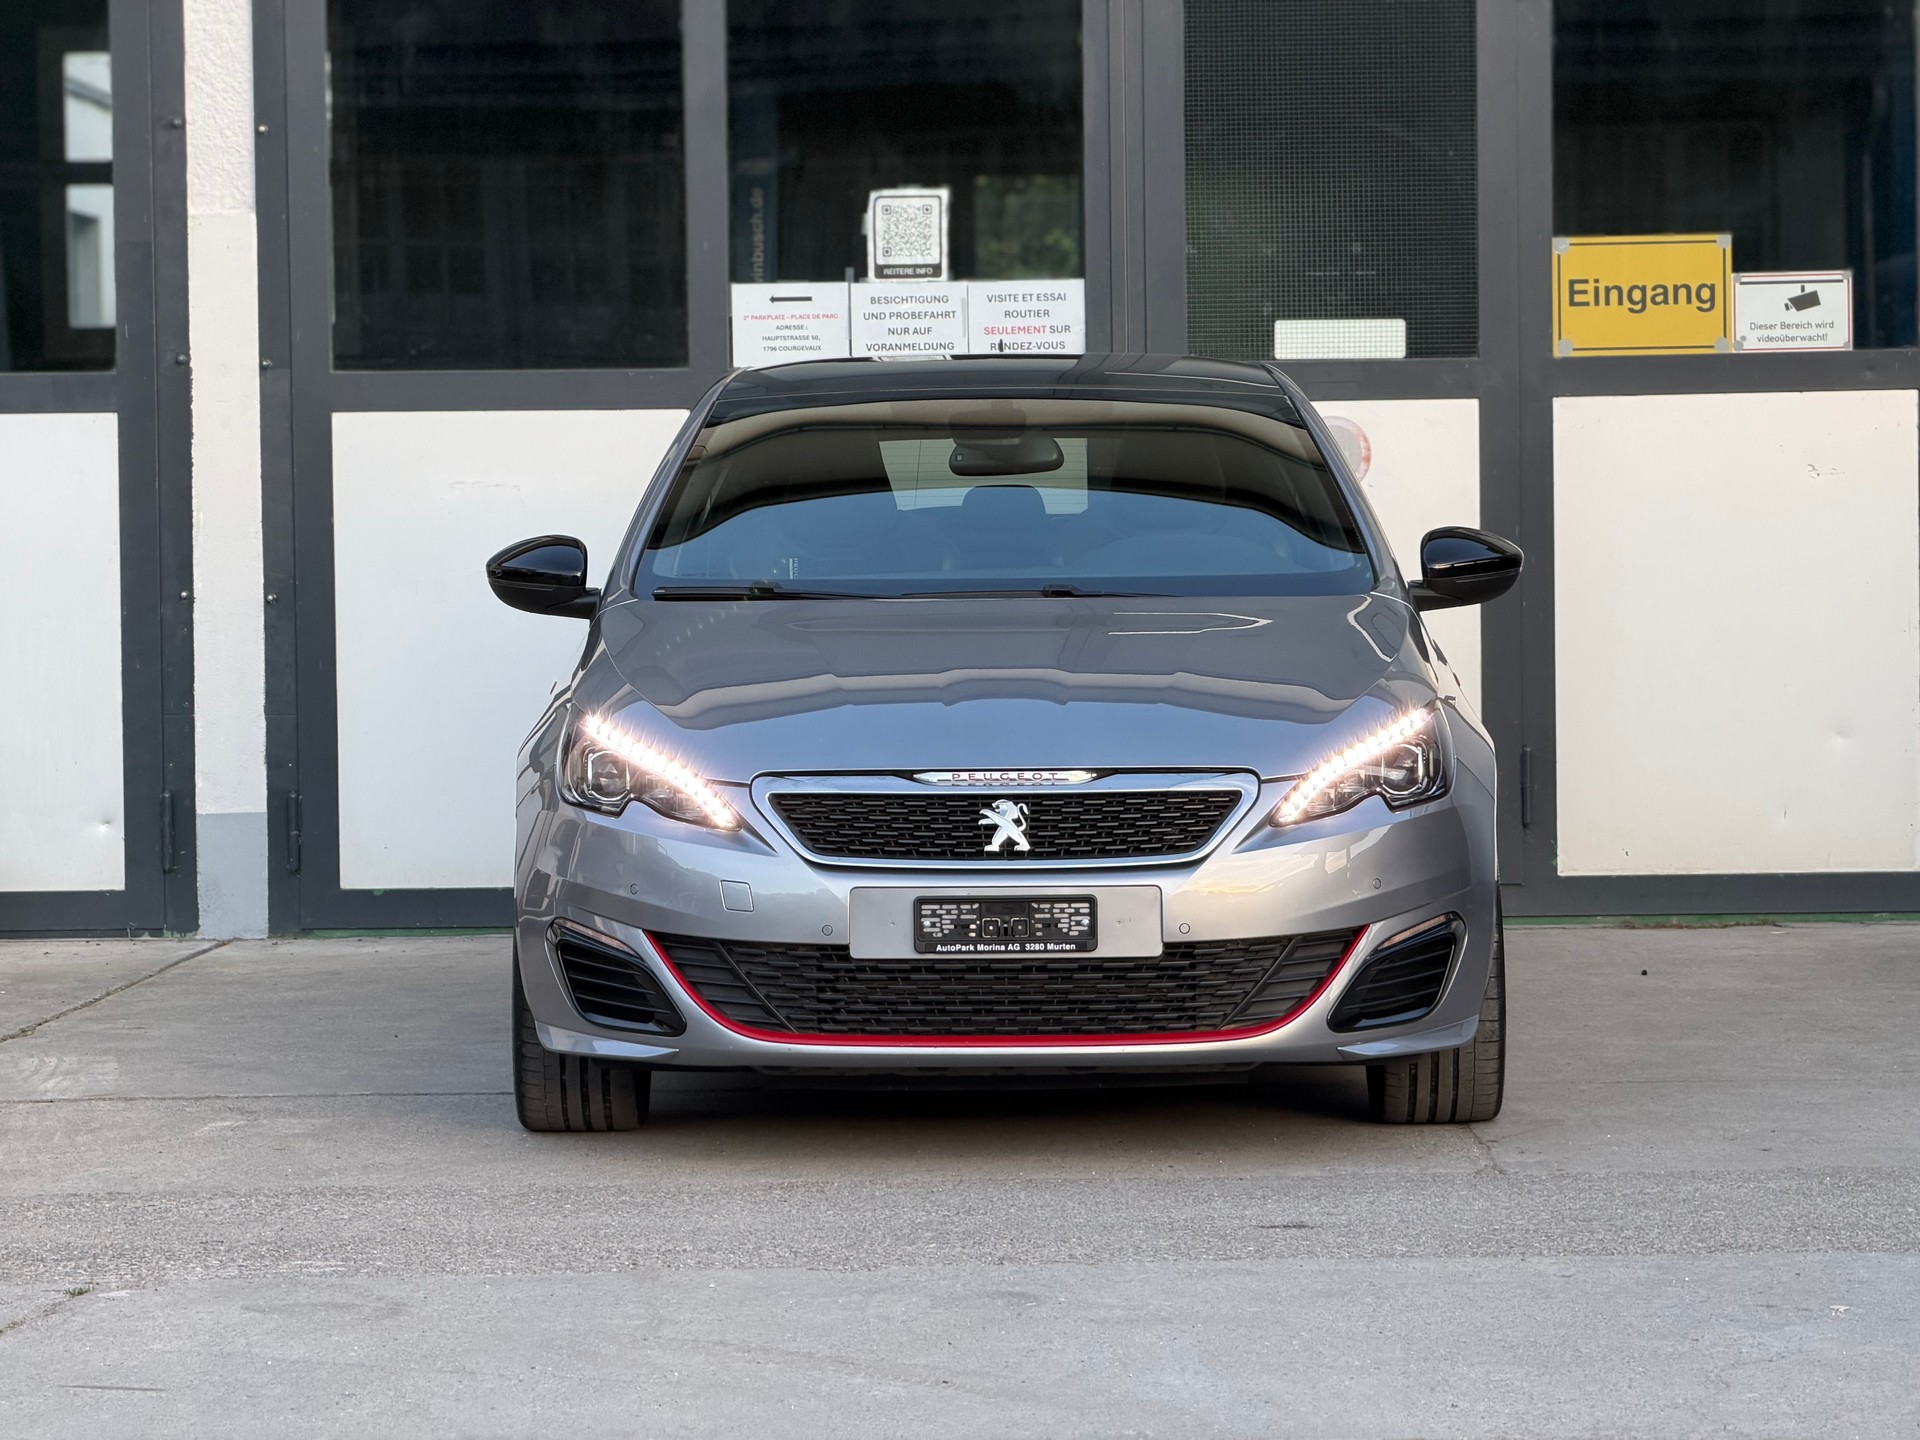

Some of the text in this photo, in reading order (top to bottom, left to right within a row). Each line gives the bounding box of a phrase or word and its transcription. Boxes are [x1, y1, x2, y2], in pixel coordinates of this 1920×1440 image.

[916, 267, 933, 275] INFO
[870, 295, 949, 305] BESICHTIGUNG
[987, 292, 1067, 303] VISITE ET ESSAI
[1568, 278, 1716, 314] Eingang
[863, 310, 957, 320] UND PROBEFAHRT
[1004, 309, 1050, 319] ROUTIER
[984, 325, 1071, 336] SEULEMENT SUR
[1749, 320, 1834, 331] Dieser Bereich wird
[887, 326, 933, 336] NUR AUF
[1757, 333, 1828, 343] videoüberwacht!
[865, 342, 955, 352] VORANMELDUNG
[990, 341, 1066, 351] RNDEZ-VOUS
[952, 772, 1058, 781] PEUGEOT
[977, 943, 1006, 951] Morina
[1007, 943, 1021, 951] AG
